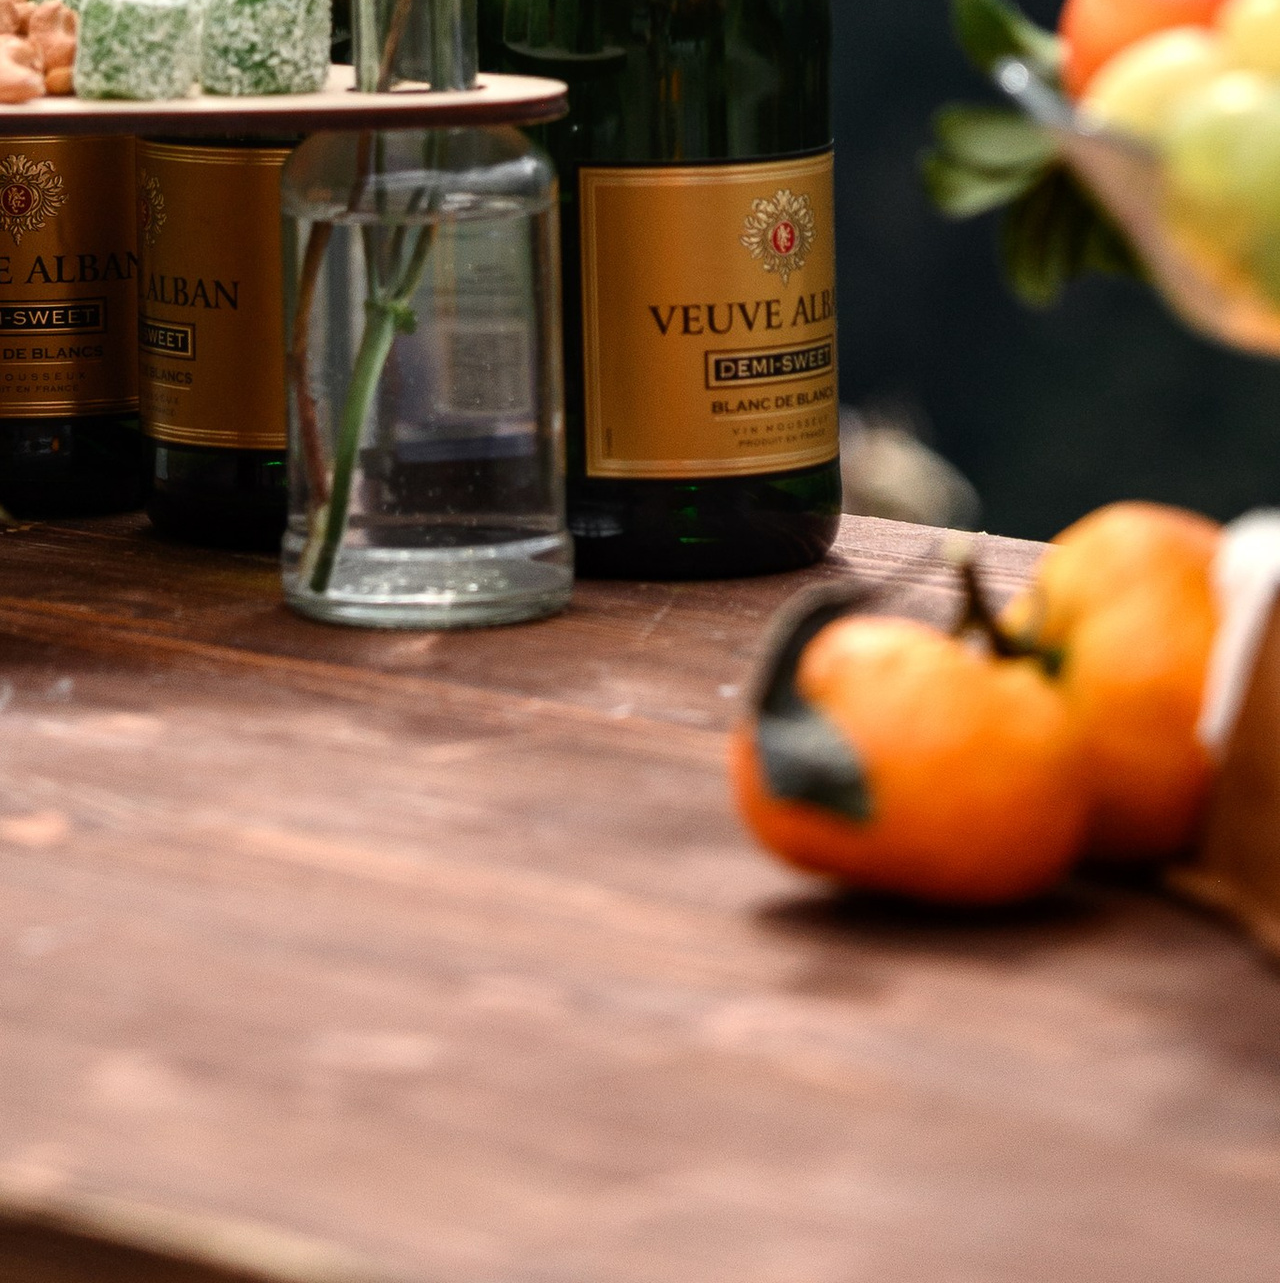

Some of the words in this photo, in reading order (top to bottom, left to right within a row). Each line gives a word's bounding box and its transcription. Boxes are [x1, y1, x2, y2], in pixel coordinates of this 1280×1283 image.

[25, 250, 139, 284] ALBAN
[146, 270, 241, 311] ALBAN
[647, 299, 783, 336] VEUVE
[2, 346, 27, 360] DE
[31, 345, 104, 360] BLANCS
[719, 347, 831, 379] DEMI-SWEET
[34, 383, 79, 393] FRANCE
[711, 397, 771, 415] BLANC
[774, 393, 796, 408] DE
